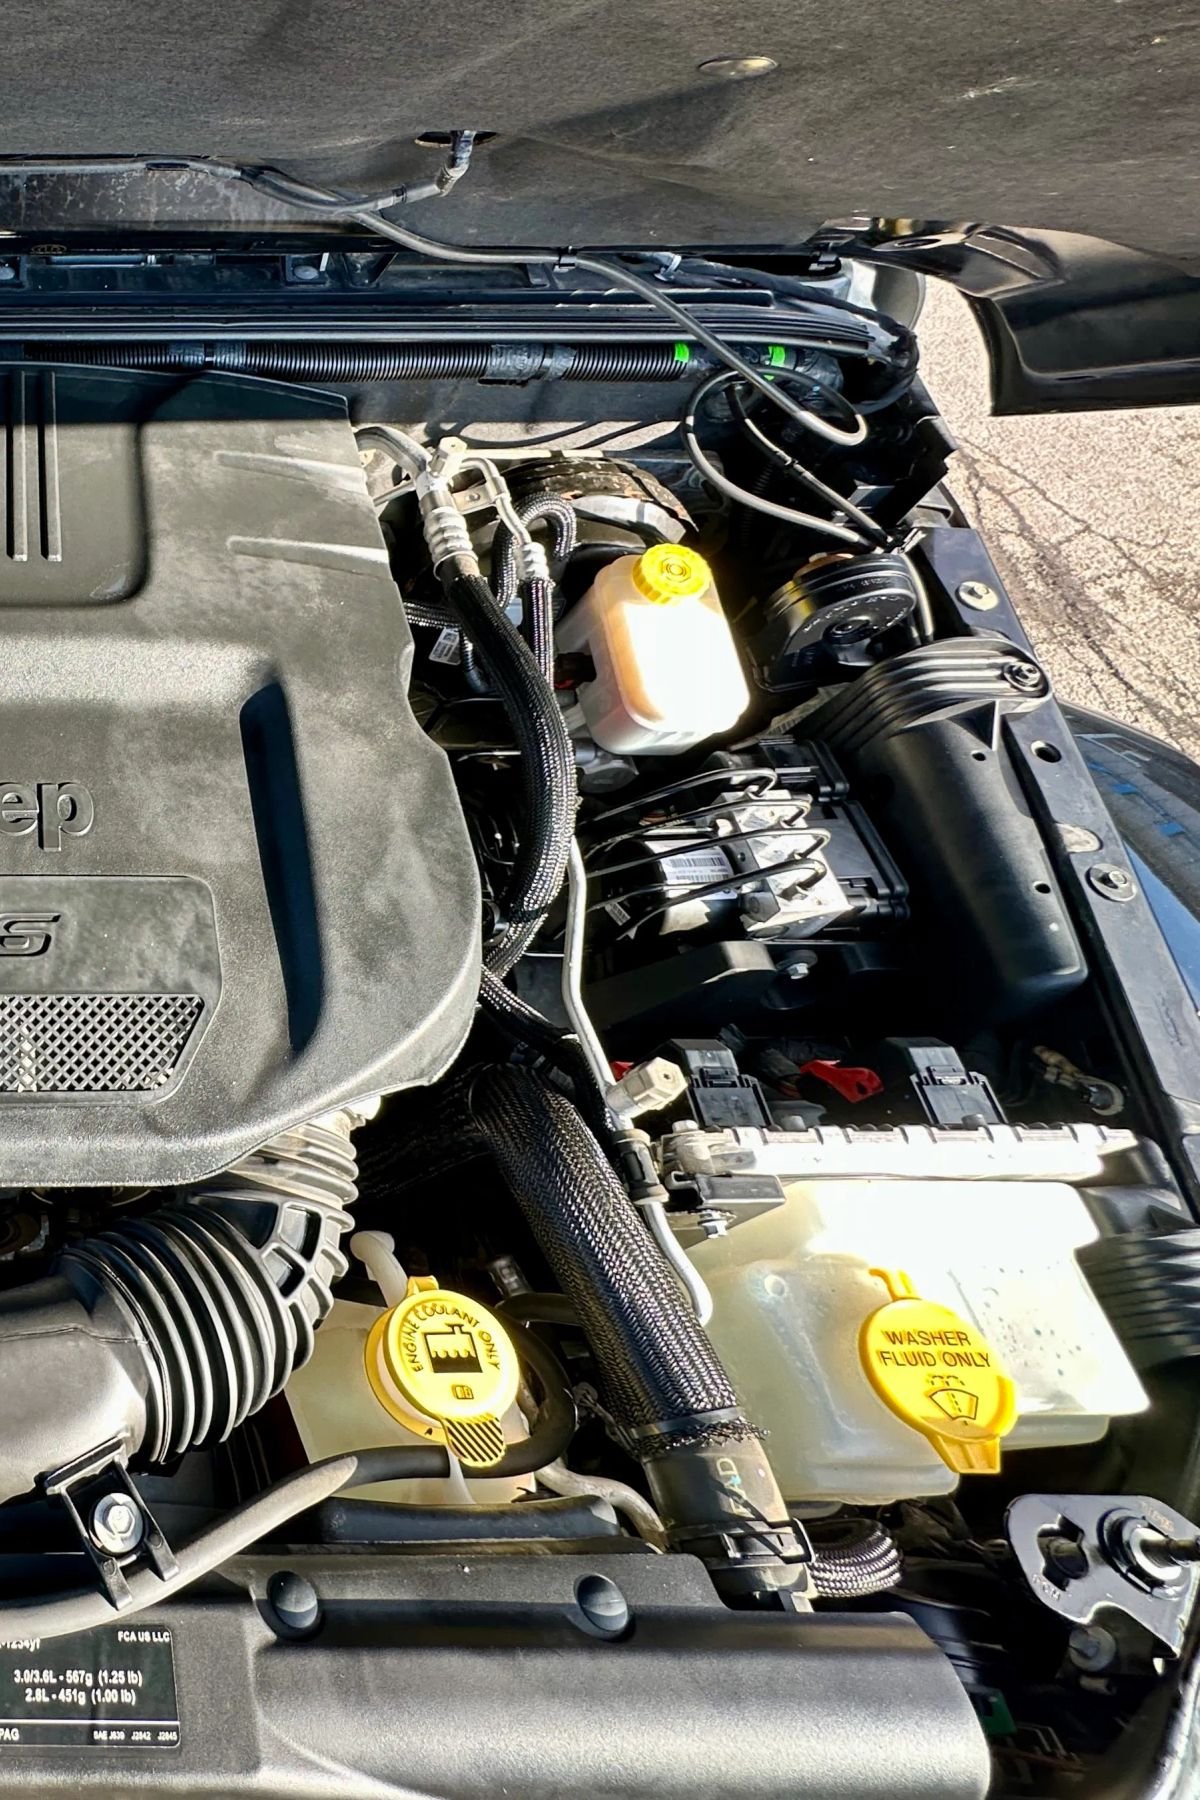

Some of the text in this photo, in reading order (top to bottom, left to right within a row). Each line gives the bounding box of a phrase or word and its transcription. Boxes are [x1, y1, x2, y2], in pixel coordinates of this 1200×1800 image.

[403, 1302, 501, 1373] ENGINE COOLANT ONLY
[882, 1330, 972, 1347] WASHER
[877, 1350, 991, 1368] FLUID ONLY
[117, 1630, 170, 1643] FCA US LLC
[13, 1668, 58, 1684] 3.0/3.6L
[65, 1669, 93, 1687] 567g
[97, 1668, 126, 1687] (1.25
[127, 1669, 143, 1688] lb)
[57, 1687, 87, 1706] 451g
[90, 1687, 119, 1706] (1.00
[120, 1688, 137, 1706] lb)
